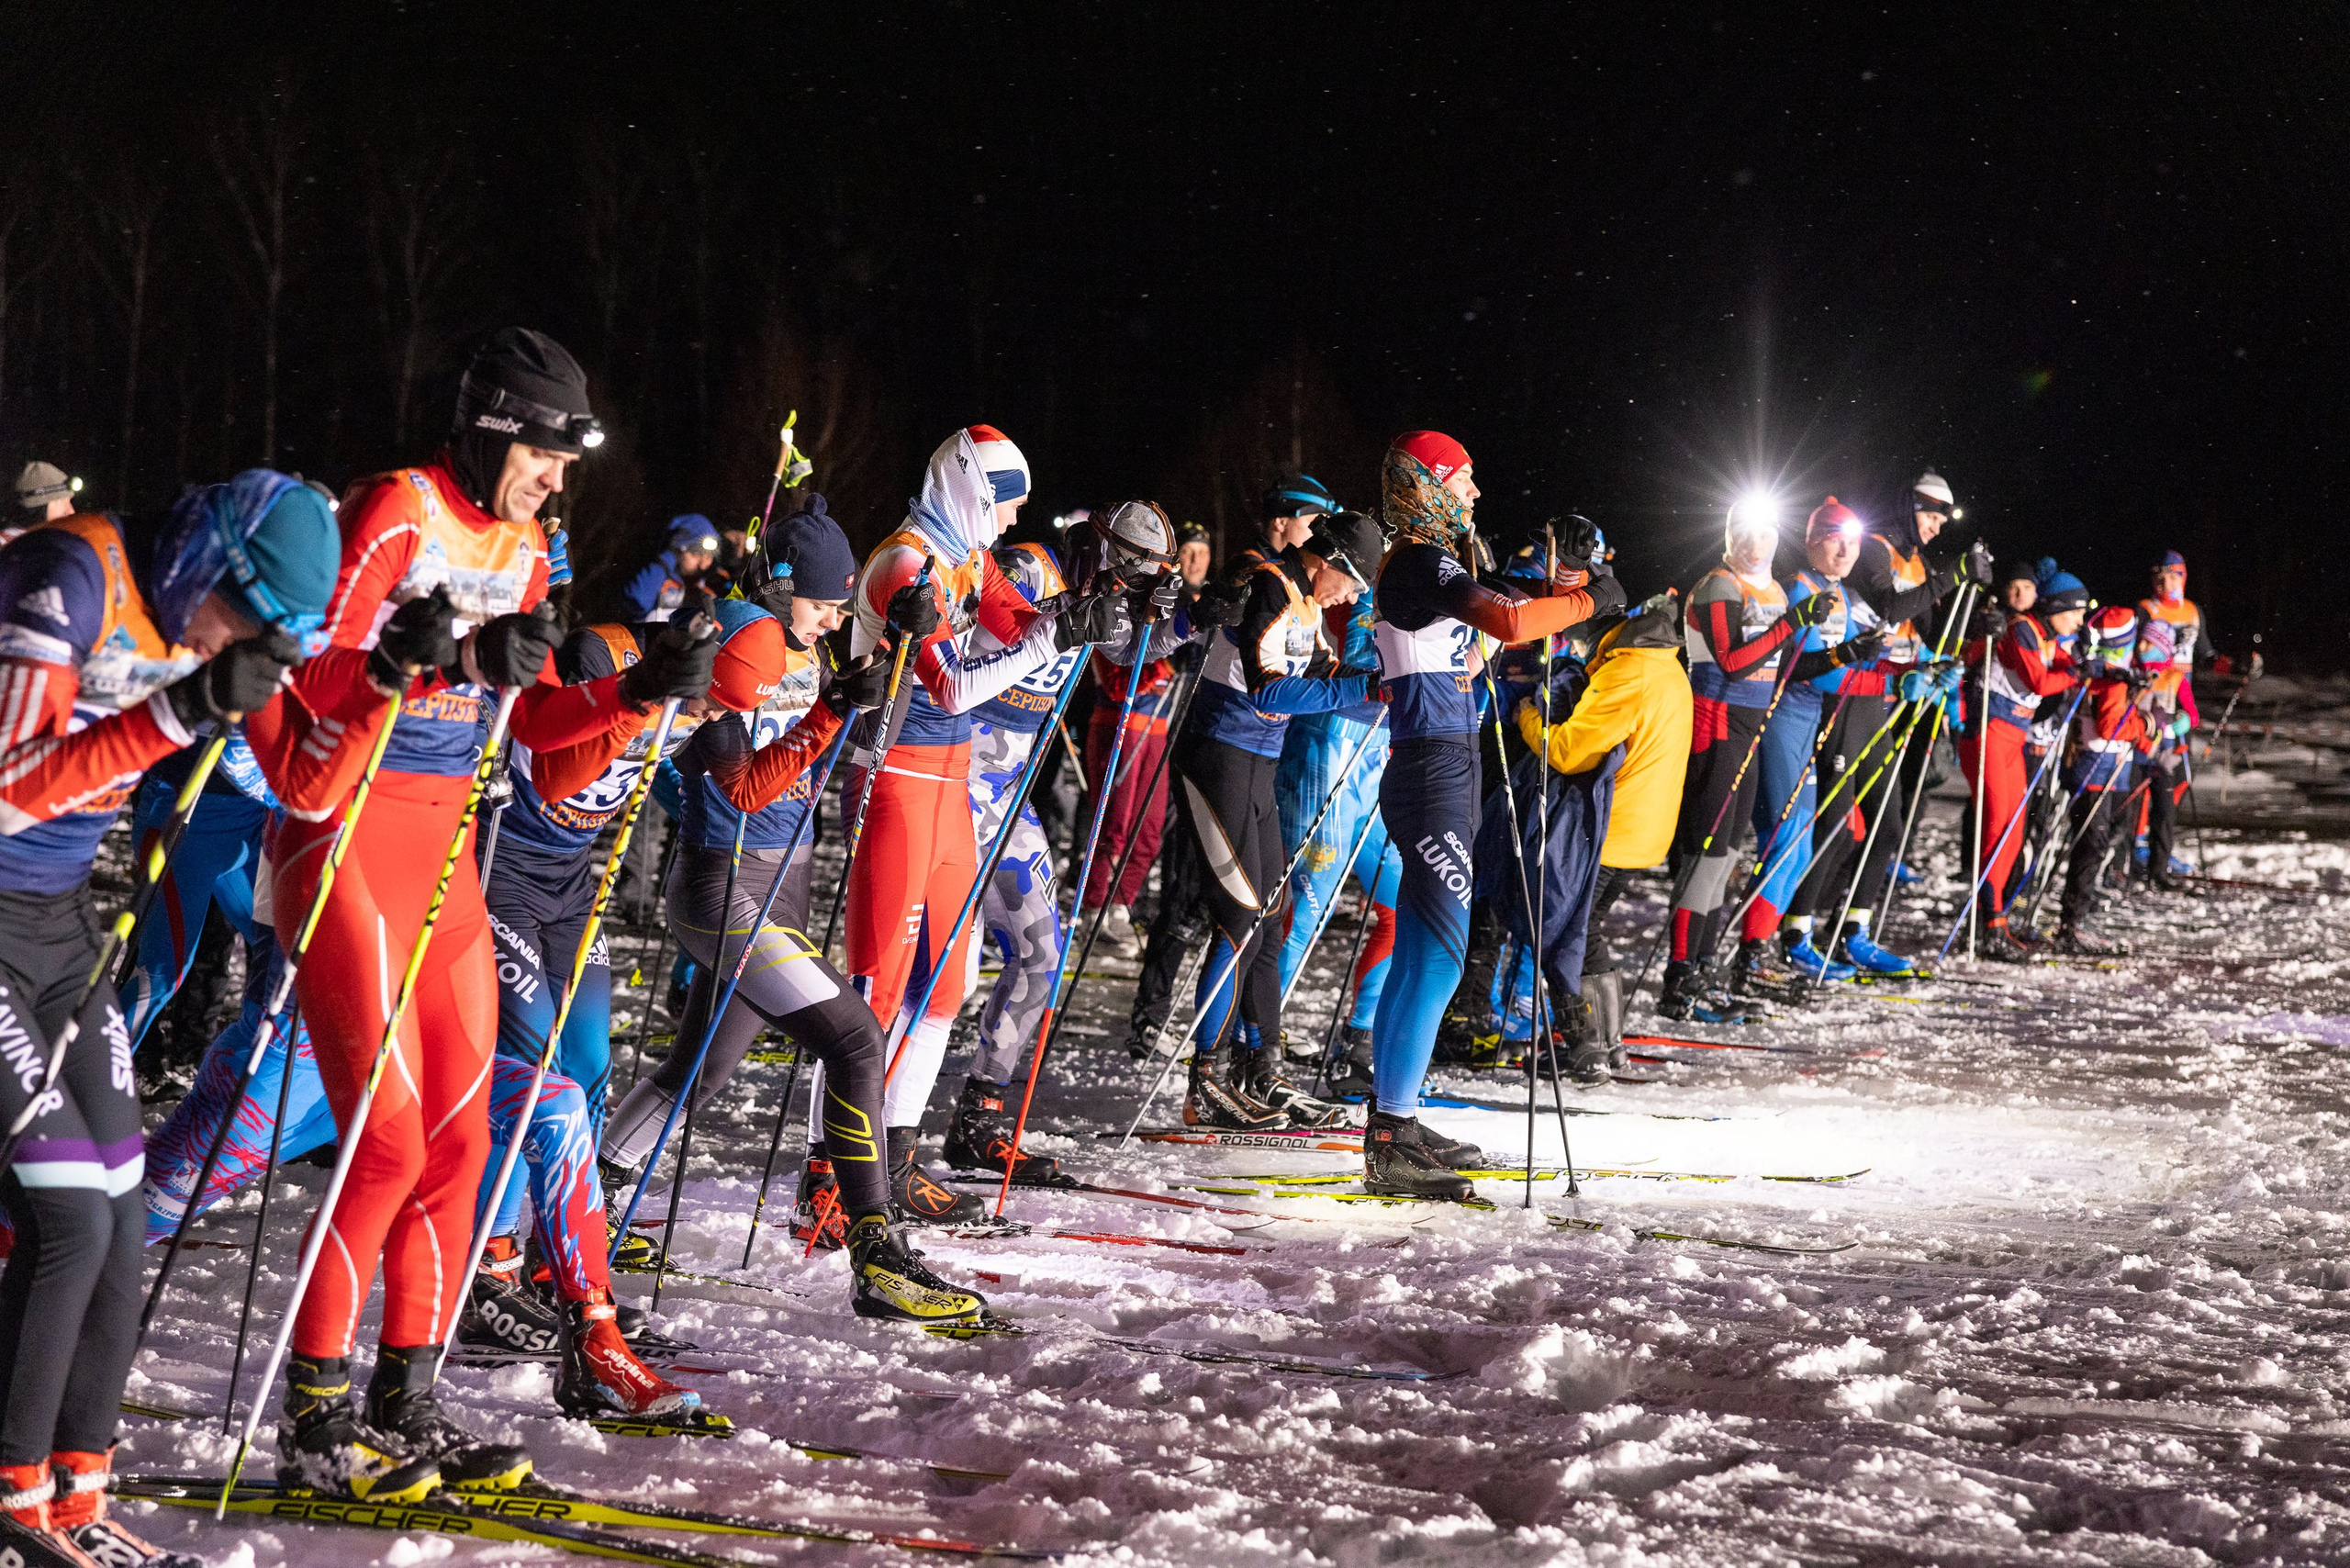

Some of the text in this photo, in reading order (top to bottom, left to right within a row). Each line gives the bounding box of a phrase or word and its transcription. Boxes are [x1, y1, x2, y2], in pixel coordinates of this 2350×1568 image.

[1415, 834, 1472, 911] LUKOIL
[1299, 874, 1320, 909] CRAFT
[487, 913, 541, 971] SCANIA
[1219, 1135, 1311, 1149] ROSSIGNOL
[151, 1203, 185, 1220] GAZPRO
[873, 1272, 953, 1310] FISER
[602, 1348, 655, 1390] alpina
[273, 1502, 473, 1534] FISCHER
